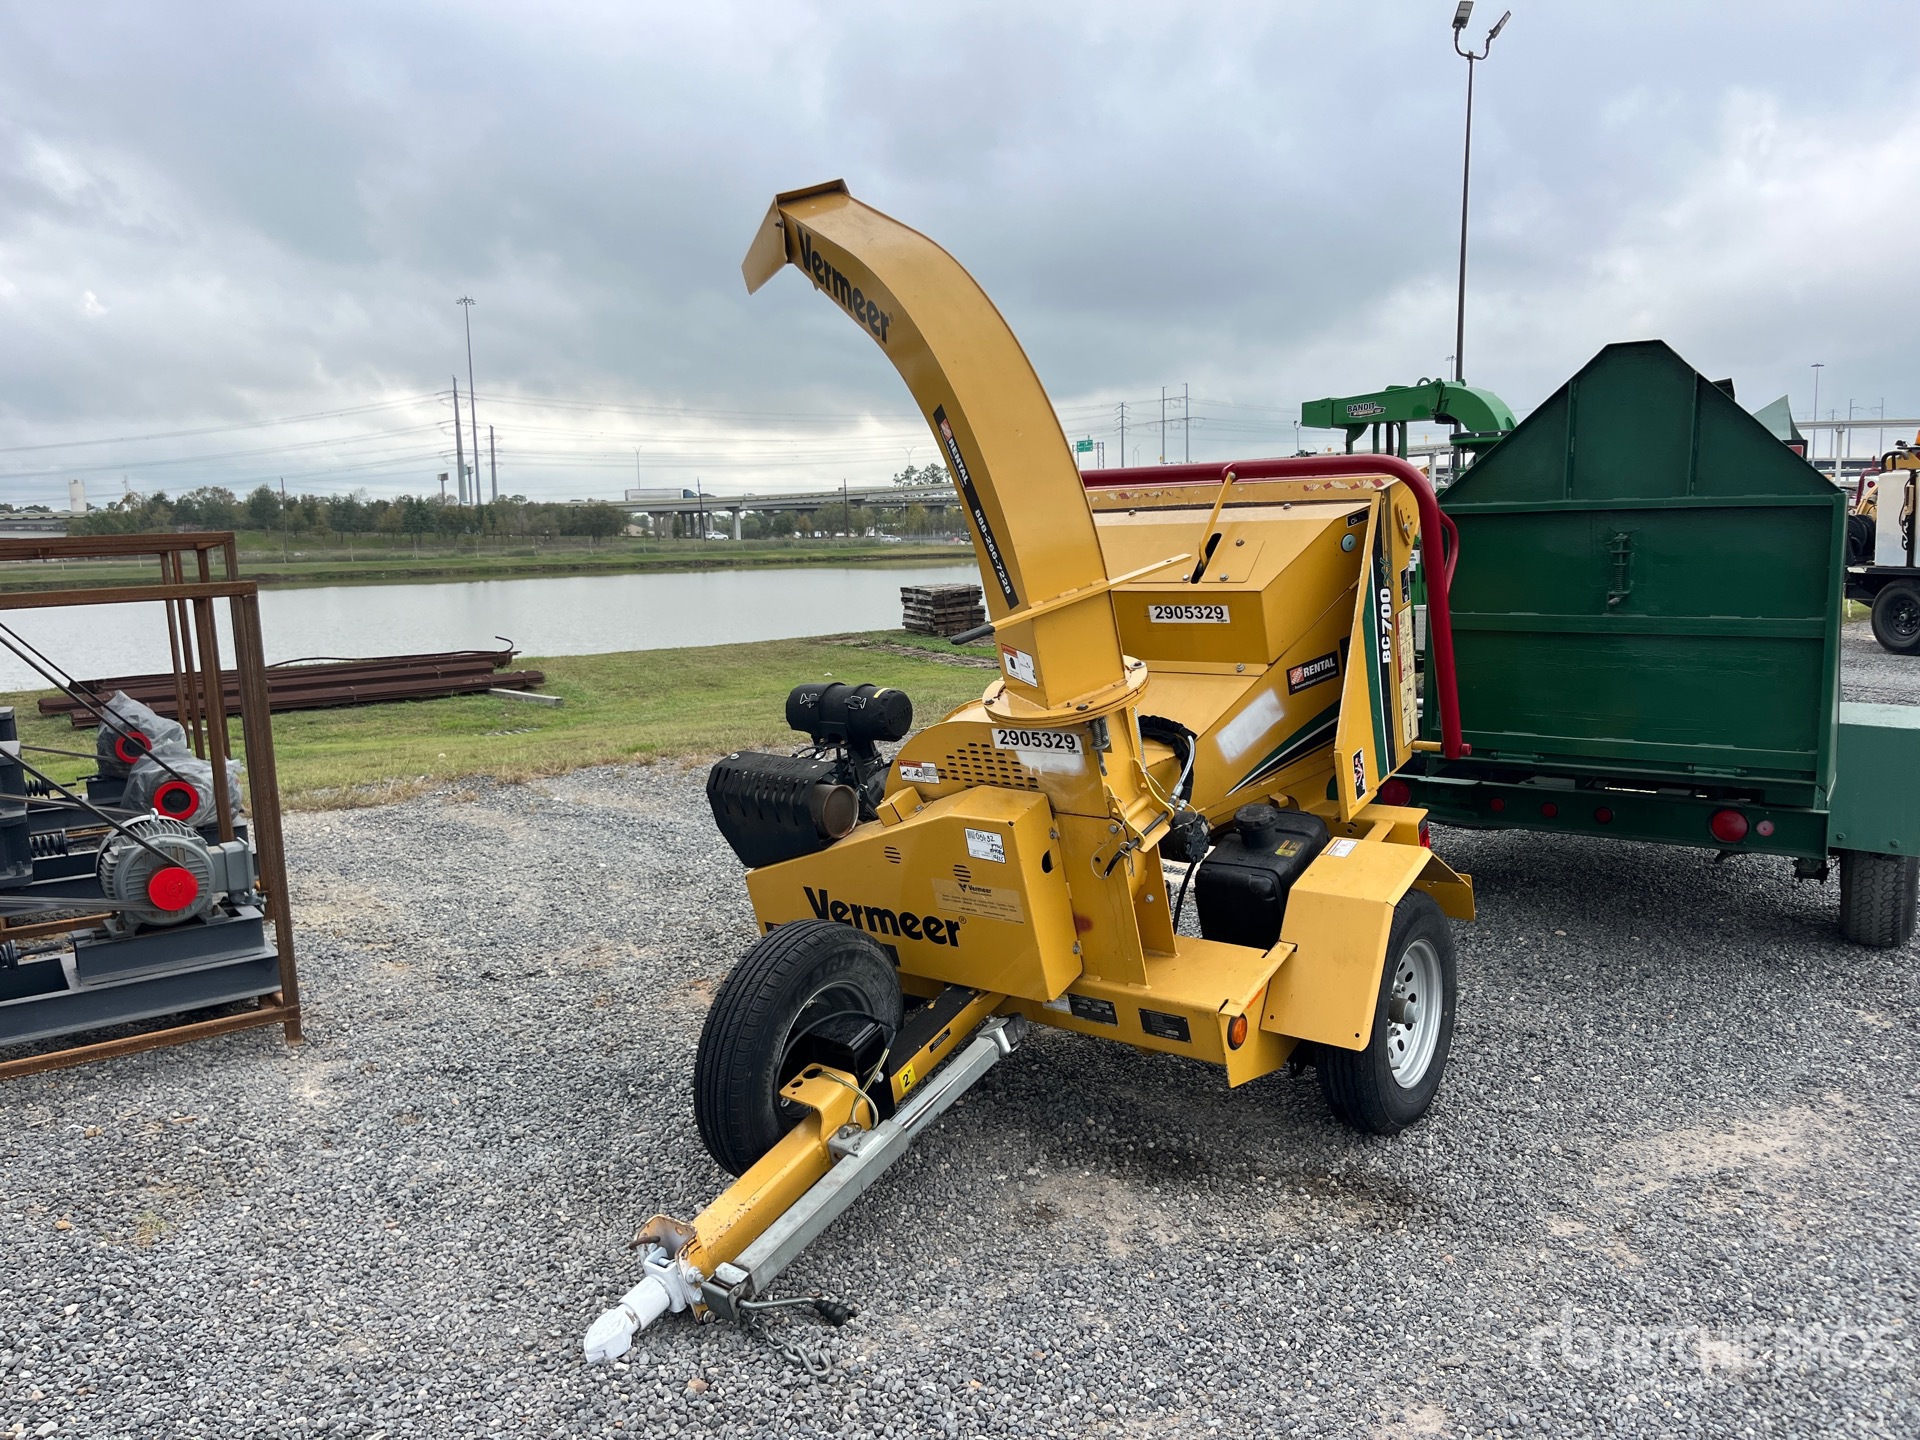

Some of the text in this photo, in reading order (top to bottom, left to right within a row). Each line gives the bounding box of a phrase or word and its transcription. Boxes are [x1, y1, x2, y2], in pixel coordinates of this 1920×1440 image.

[796, 224, 891, 344] Vermeer
[1347, 402, 1376, 413] BANDIT
[948, 438, 968, 486] RENTAL
[974, 509, 1011, 595] 888-266-7228
[1154, 605, 1224, 620] 2905329
[1303, 658, 1336, 678] RENTAL
[998, 729, 1075, 750] 2905329
[968, 884, 992, 894] Vermeer
[803, 886, 961, 948] Vermeer
